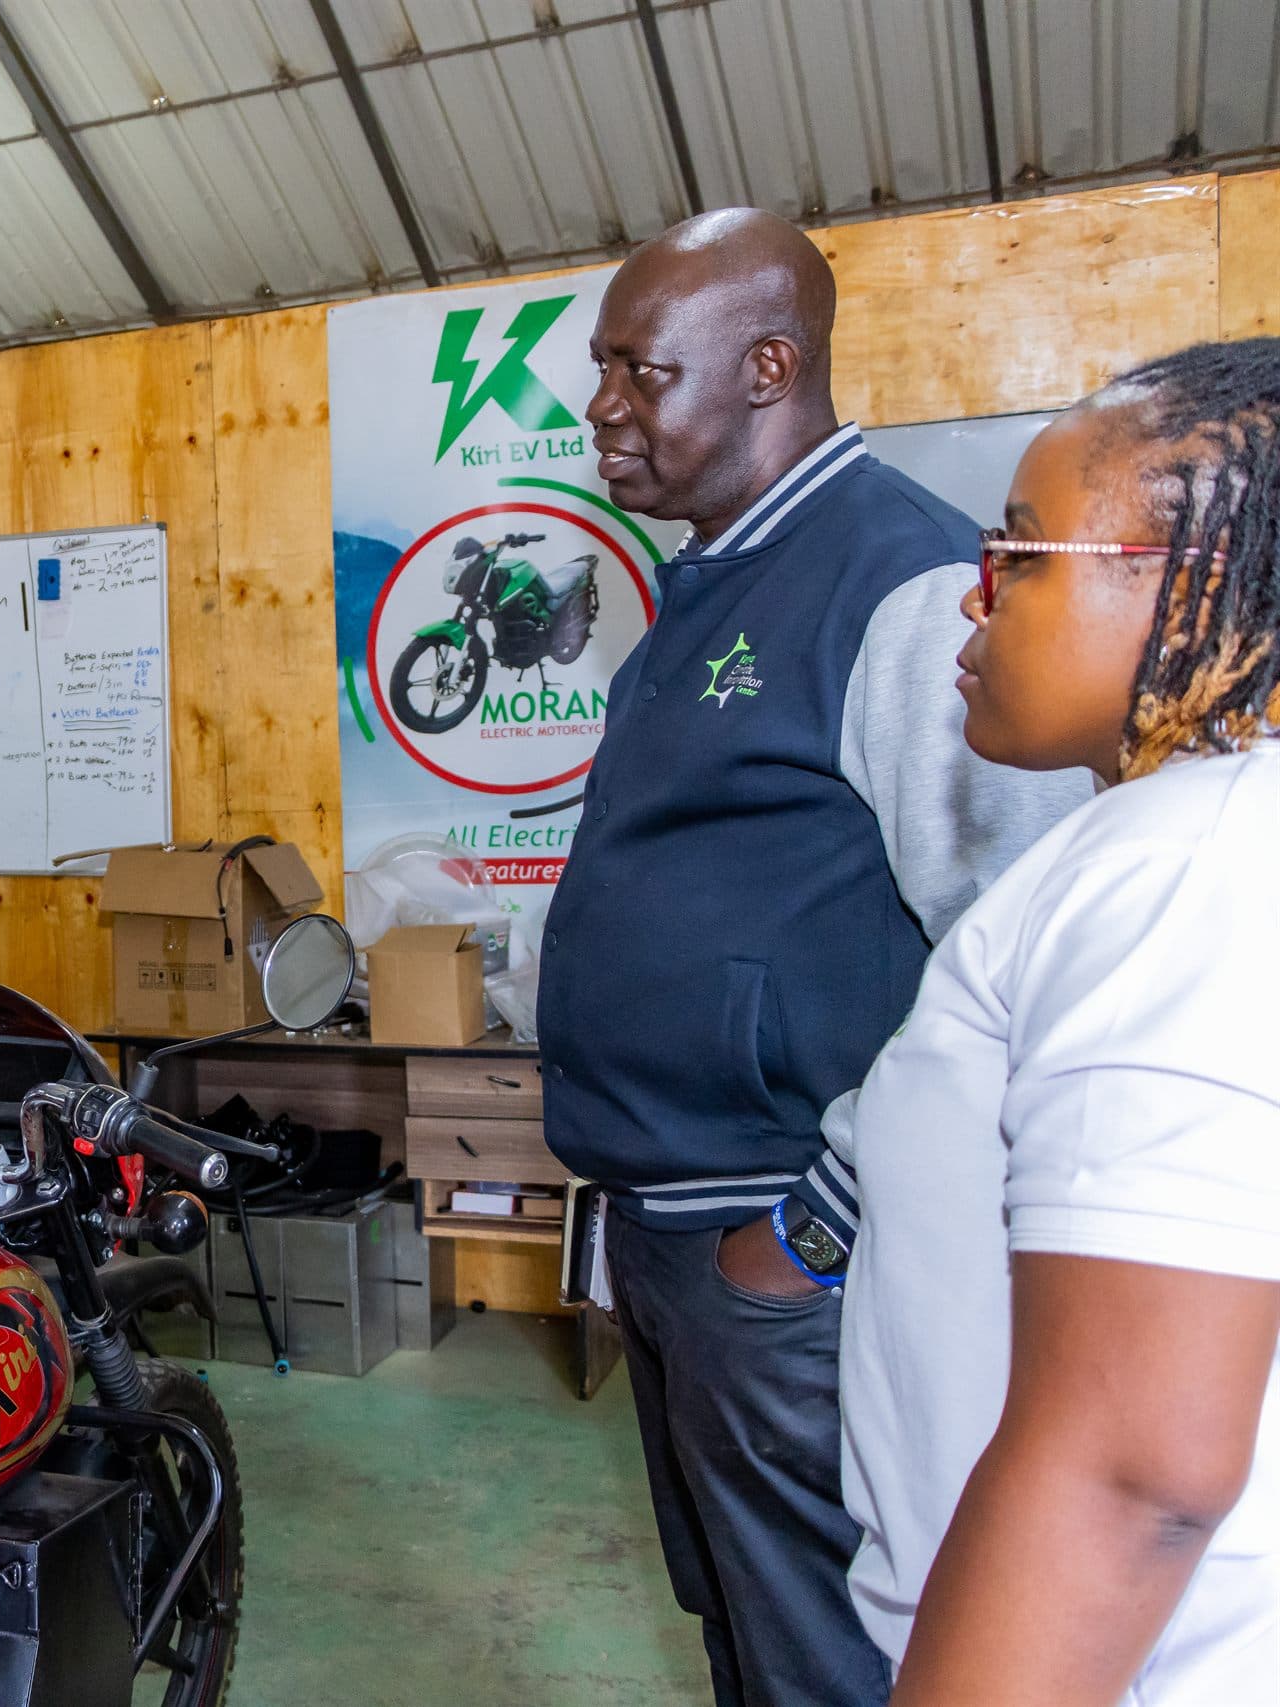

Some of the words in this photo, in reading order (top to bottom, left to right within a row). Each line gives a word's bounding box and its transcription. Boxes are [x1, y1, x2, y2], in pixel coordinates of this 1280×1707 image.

[460, 444, 501, 467] Kiri
[509, 440, 540, 462] EV
[546, 435, 585, 458] Ltd
[480, 727, 533, 739] ELECTRIC
[446, 825, 477, 847] All
